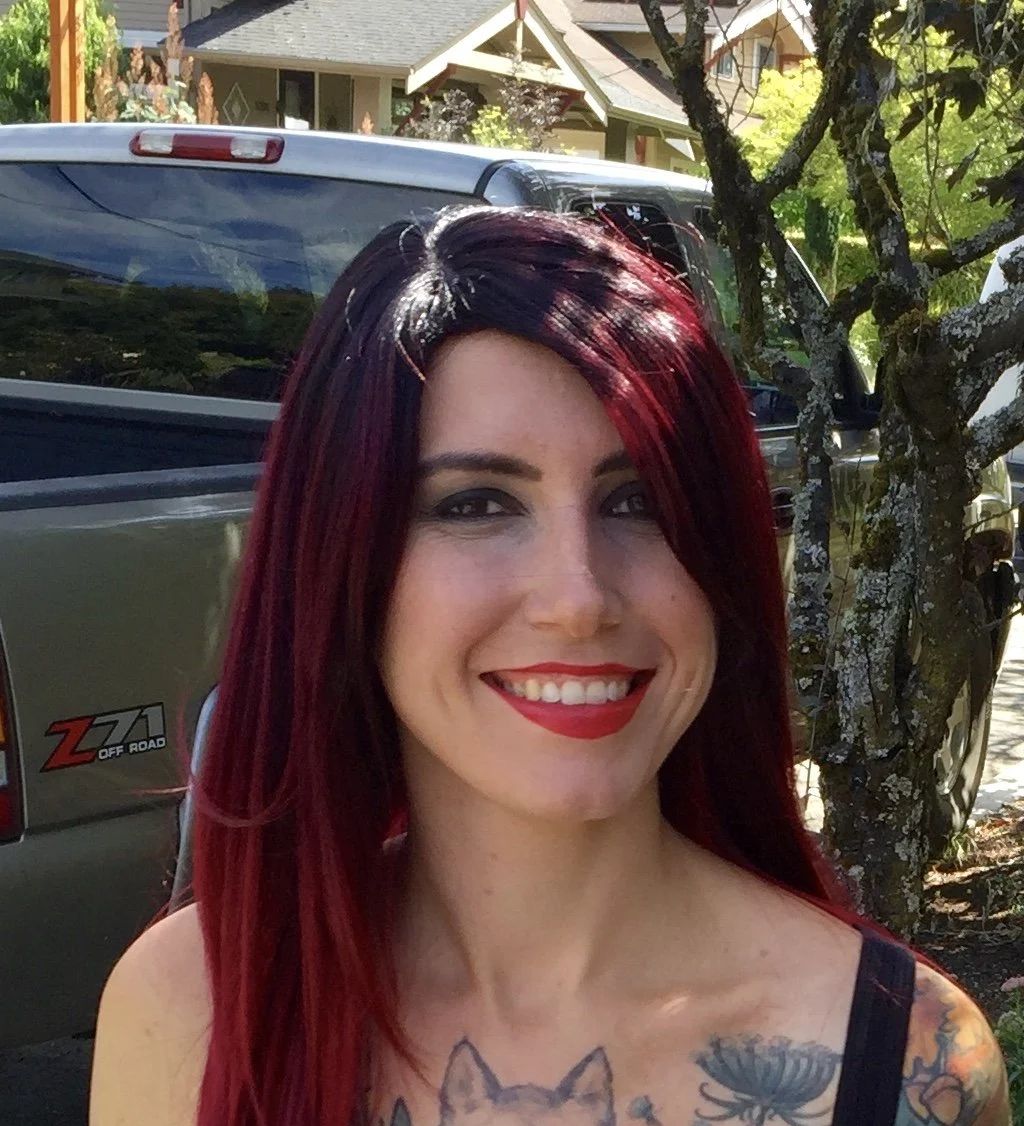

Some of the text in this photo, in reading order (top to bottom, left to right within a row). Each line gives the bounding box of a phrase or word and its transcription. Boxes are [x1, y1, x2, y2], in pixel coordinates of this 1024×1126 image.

[41, 702, 165, 772] Z71
[98, 737, 166, 760] OFF ROAD
